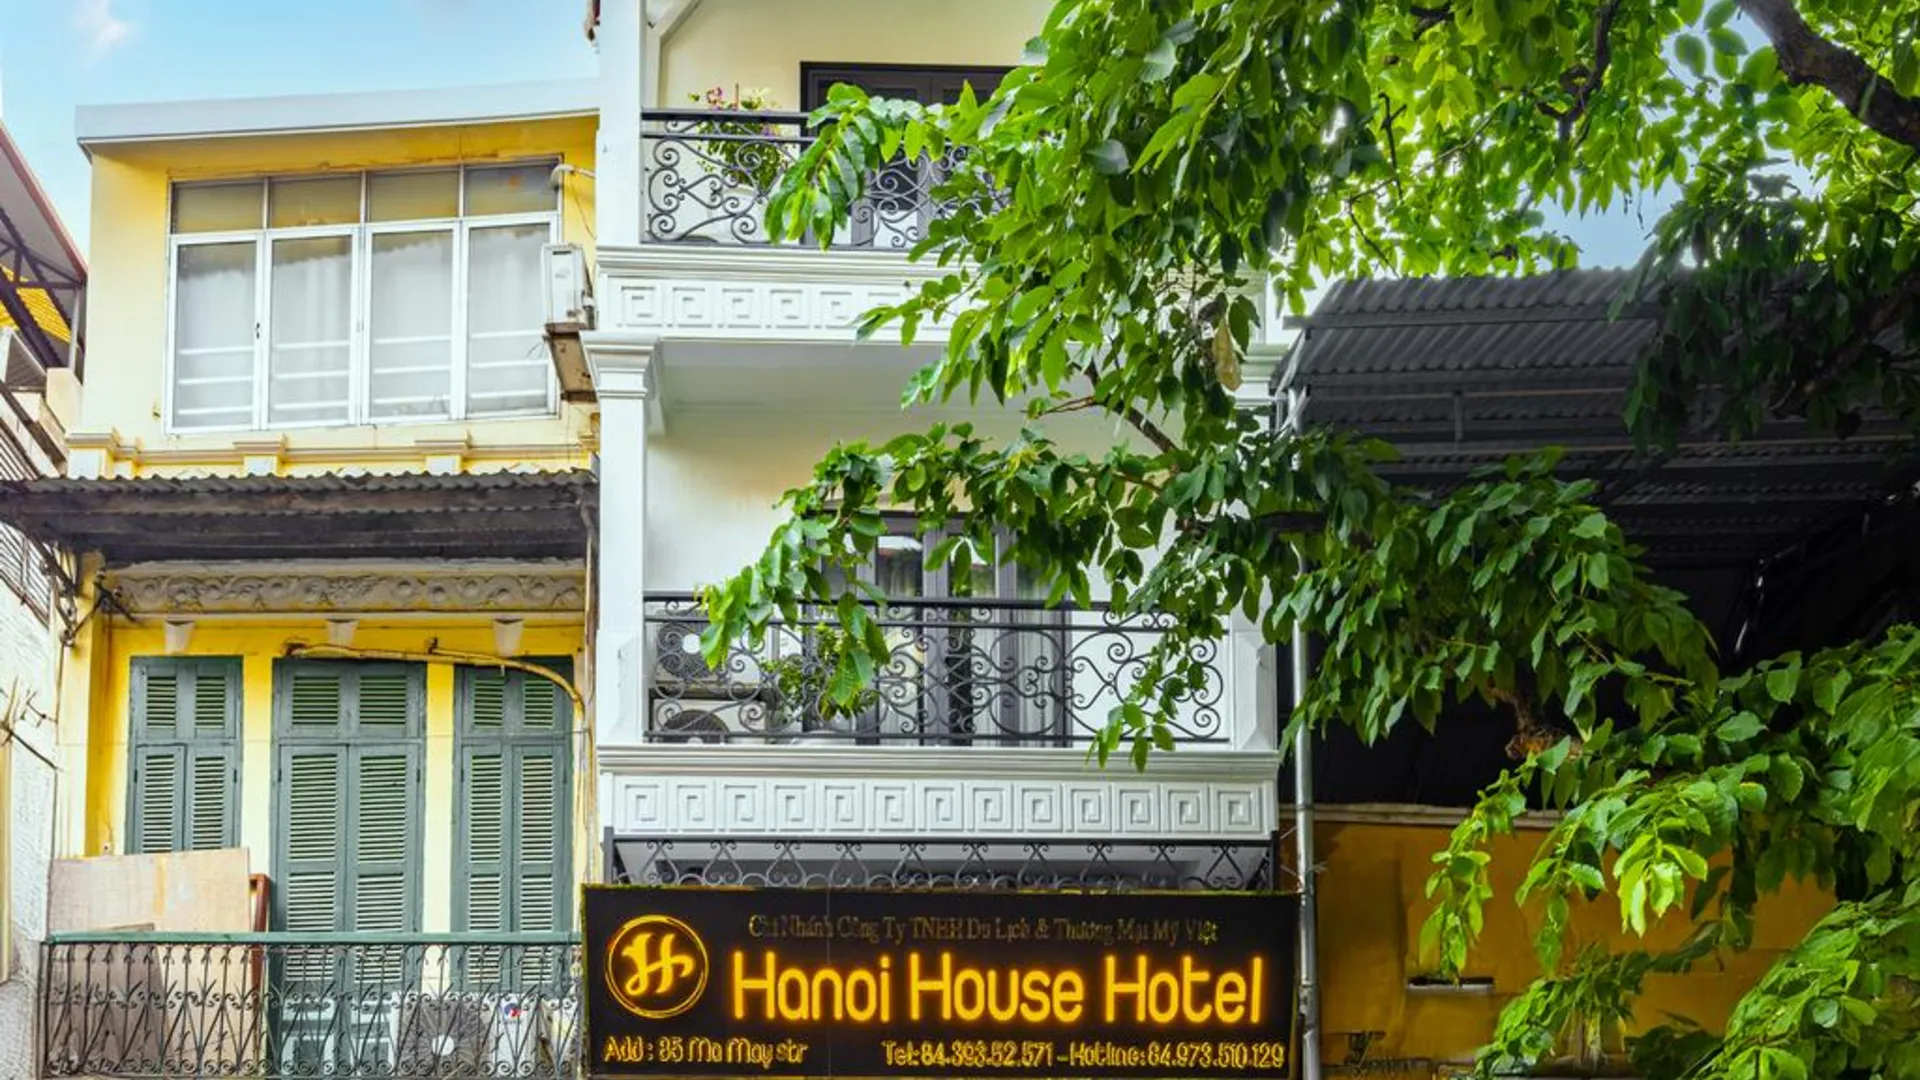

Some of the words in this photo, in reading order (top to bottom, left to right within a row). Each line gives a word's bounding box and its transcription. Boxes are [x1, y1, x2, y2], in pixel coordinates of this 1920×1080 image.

[882, 916, 906, 945] Ty
[733, 950, 891, 1023] Hanoi
[909, 952, 1084, 1023] House
[1105, 954, 1263, 1024] Hotel
[688, 1036, 723, 1063] Ma
[725, 1037, 774, 1070] May
